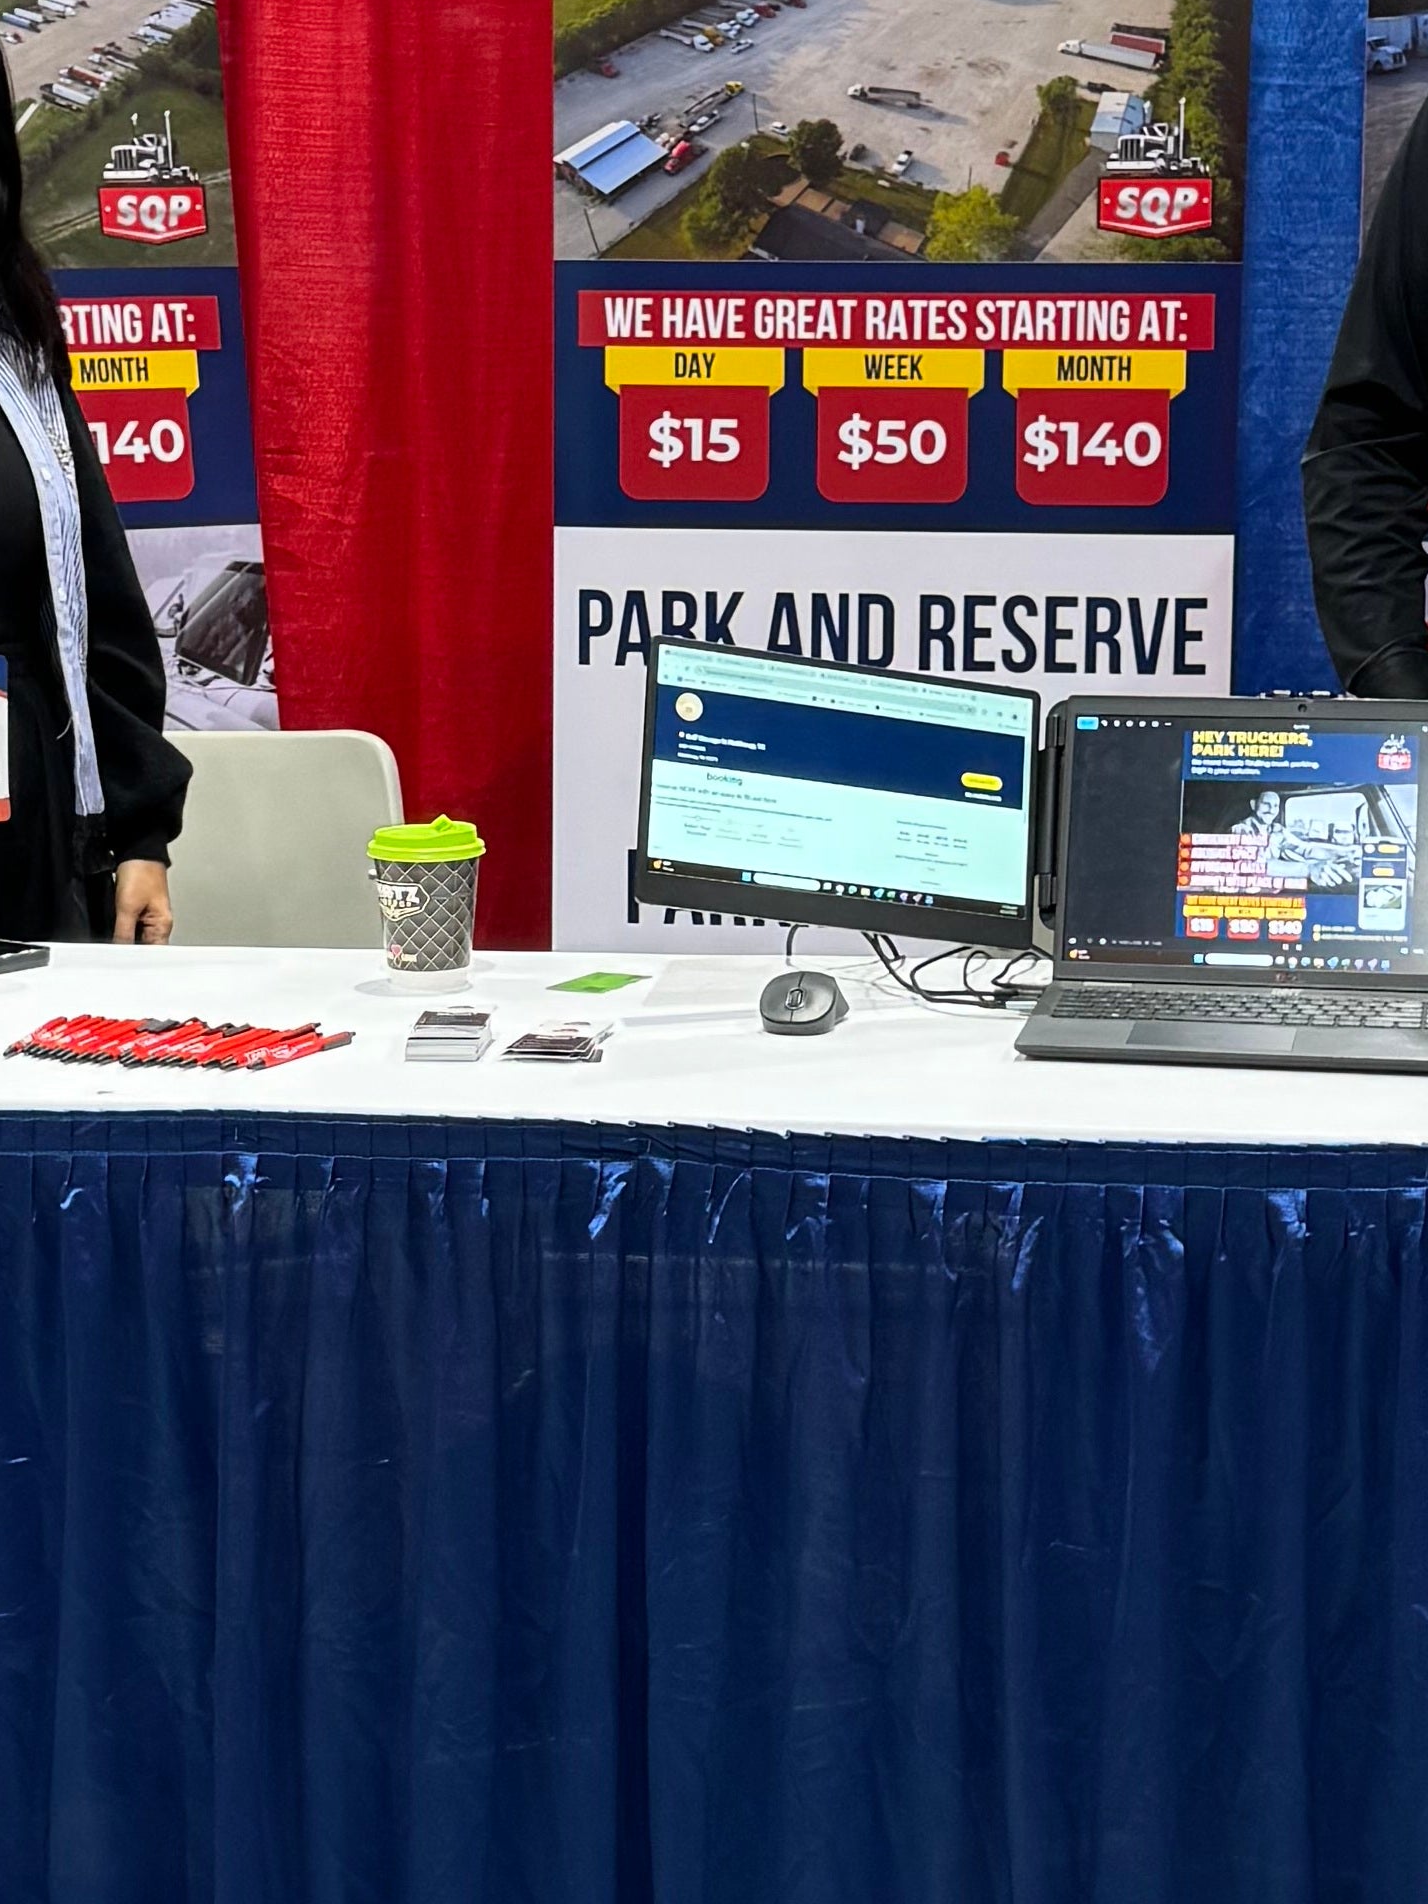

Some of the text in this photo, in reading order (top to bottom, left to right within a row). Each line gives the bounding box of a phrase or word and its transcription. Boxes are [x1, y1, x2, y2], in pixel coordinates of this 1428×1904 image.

[117, 194, 192, 232] SQP
[1116, 186, 1199, 226] SQP
[58, 302, 196, 345] RTING AT:
[604, 297, 1189, 343] WE HAVE GREAT RATES STARTING AT:
[79, 356, 149, 383] MONTH
[673, 351, 716, 380] DAY
[864, 353, 923, 382] WEEK
[1056, 354, 1133, 382] MONTH
[87, 418, 185, 465] 140
[648, 410, 741, 468] $15
[837, 412, 948, 470] $50
[1023, 414, 1162, 472] $140
[578, 589, 1208, 675] PARK AND RESERVE
[1191, 744, 1235, 757] PARK
[1192, 730, 1225, 744] HEY
[706, 771, 744, 787] booking
